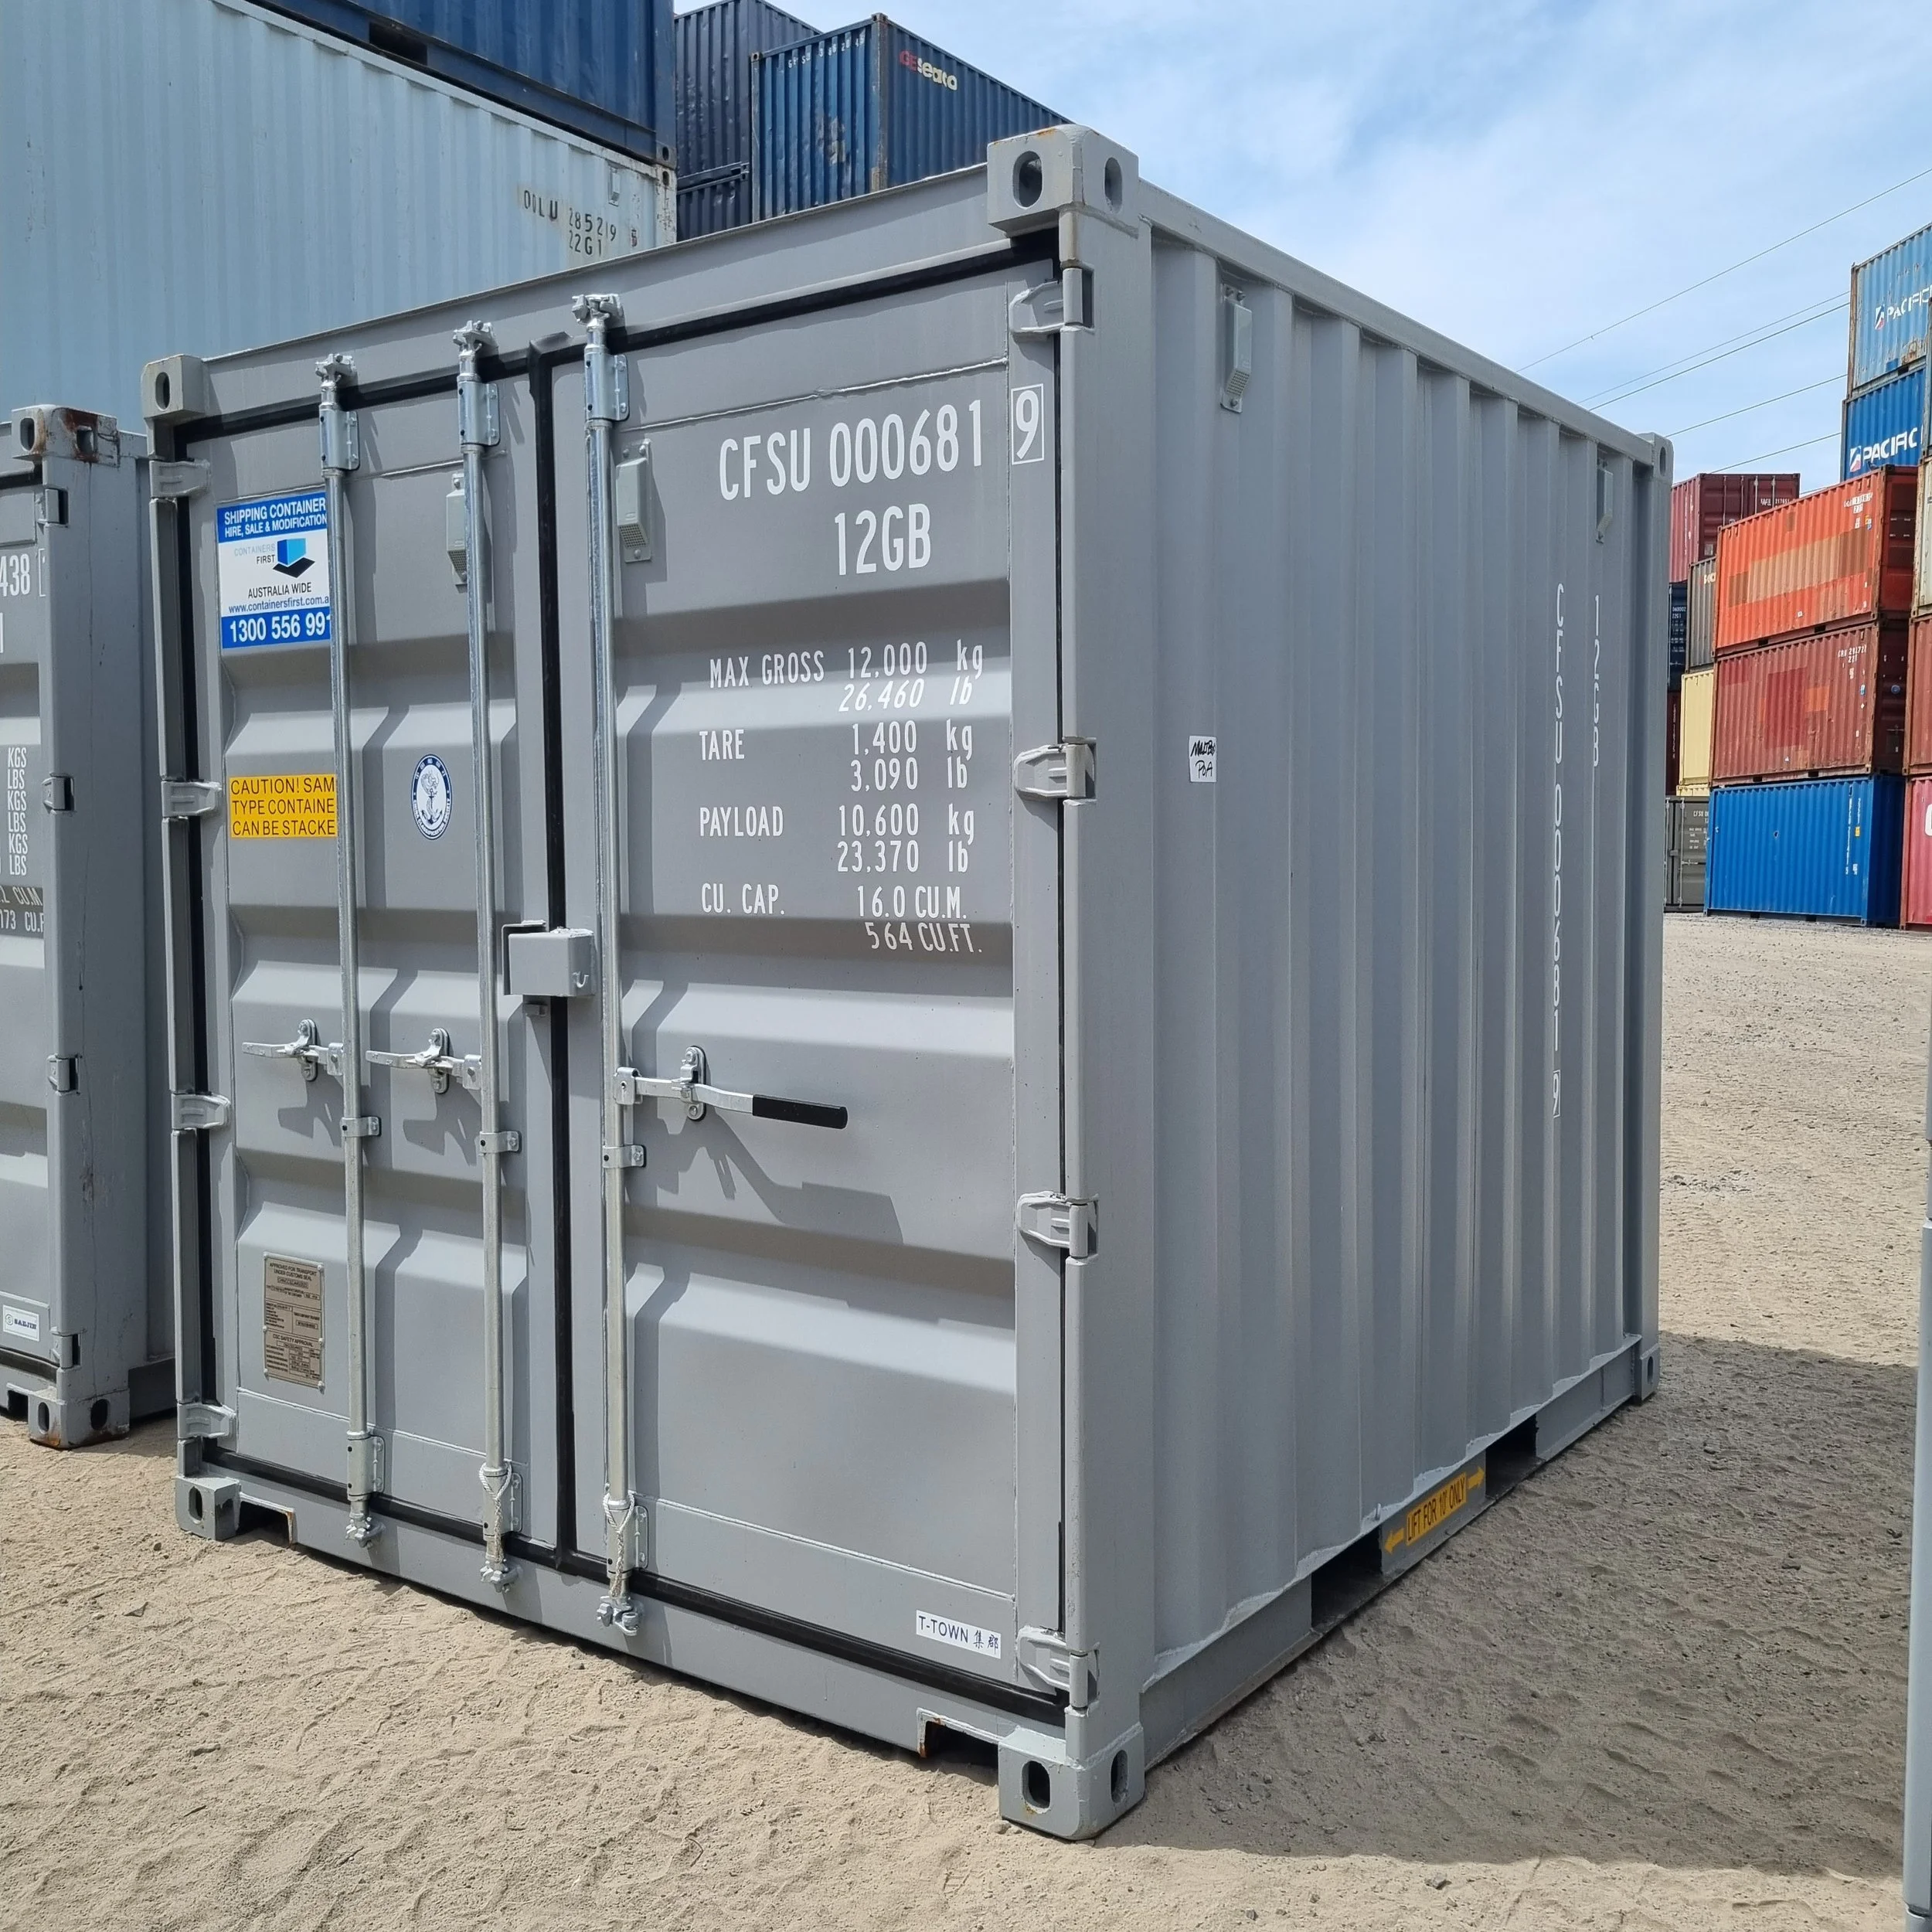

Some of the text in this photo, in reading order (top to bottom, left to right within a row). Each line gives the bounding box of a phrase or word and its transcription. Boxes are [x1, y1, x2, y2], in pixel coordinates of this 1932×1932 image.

[569, 207, 617, 241] 285219
[569, 230, 602, 256] 22G1
[719, 390, 1039, 501] CFSU 000681 9
[224, 497, 326, 526] SHIPPING CONTAINER
[225, 525, 244, 539] HIRE,
[245, 522, 264, 536] SALE
[265, 522, 270, 532] &
[835, 503, 930, 576] 12GB
[234, 543, 275, 556] CONTAINERS
[257, 554, 276, 564] FIRST
[248, 582, 312, 599] AUSTRALIA WIDE
[229, 596, 330, 614] www.containersfirst.com.a
[230, 617, 267, 643] 1300
[272, 614, 301, 639] 556
[709, 639, 982, 688] MAX GROSS 12,000 kg
[838, 677, 972, 712] 26,460 lb
[699, 719, 972, 760] TARE 1,400 kg
[8, 747, 26, 768] KGS
[8, 769, 25, 790] LBS
[231, 777, 335, 795] CAUTION! SAM
[850, 756, 968, 791] 3,090 lb
[8, 790, 26, 811] KGS
[232, 798, 335, 815] TYPE CONTAINE
[9, 811, 26, 832] LBS
[233, 819, 335, 835] CAN BE STACKE
[700, 804, 974, 845] PAYLOAD 10,600 kg
[9, 833, 28, 855] KGS
[837, 840, 968, 872] 23,370 lb
[9, 855, 27, 876] LBS
[702, 883, 730, 913] CU.
[742, 884, 785, 915] CAP.
[857, 886, 905, 919] 16.0
[865, 922, 913, 951] 564
[1407, 1509, 1421, 1542] LIFT
[1423, 1498, 1437, 1529] FOR
[1449, 1477, 1465, 1509] ONLY
[919, 1616, 968, 1643] T-TOWN
